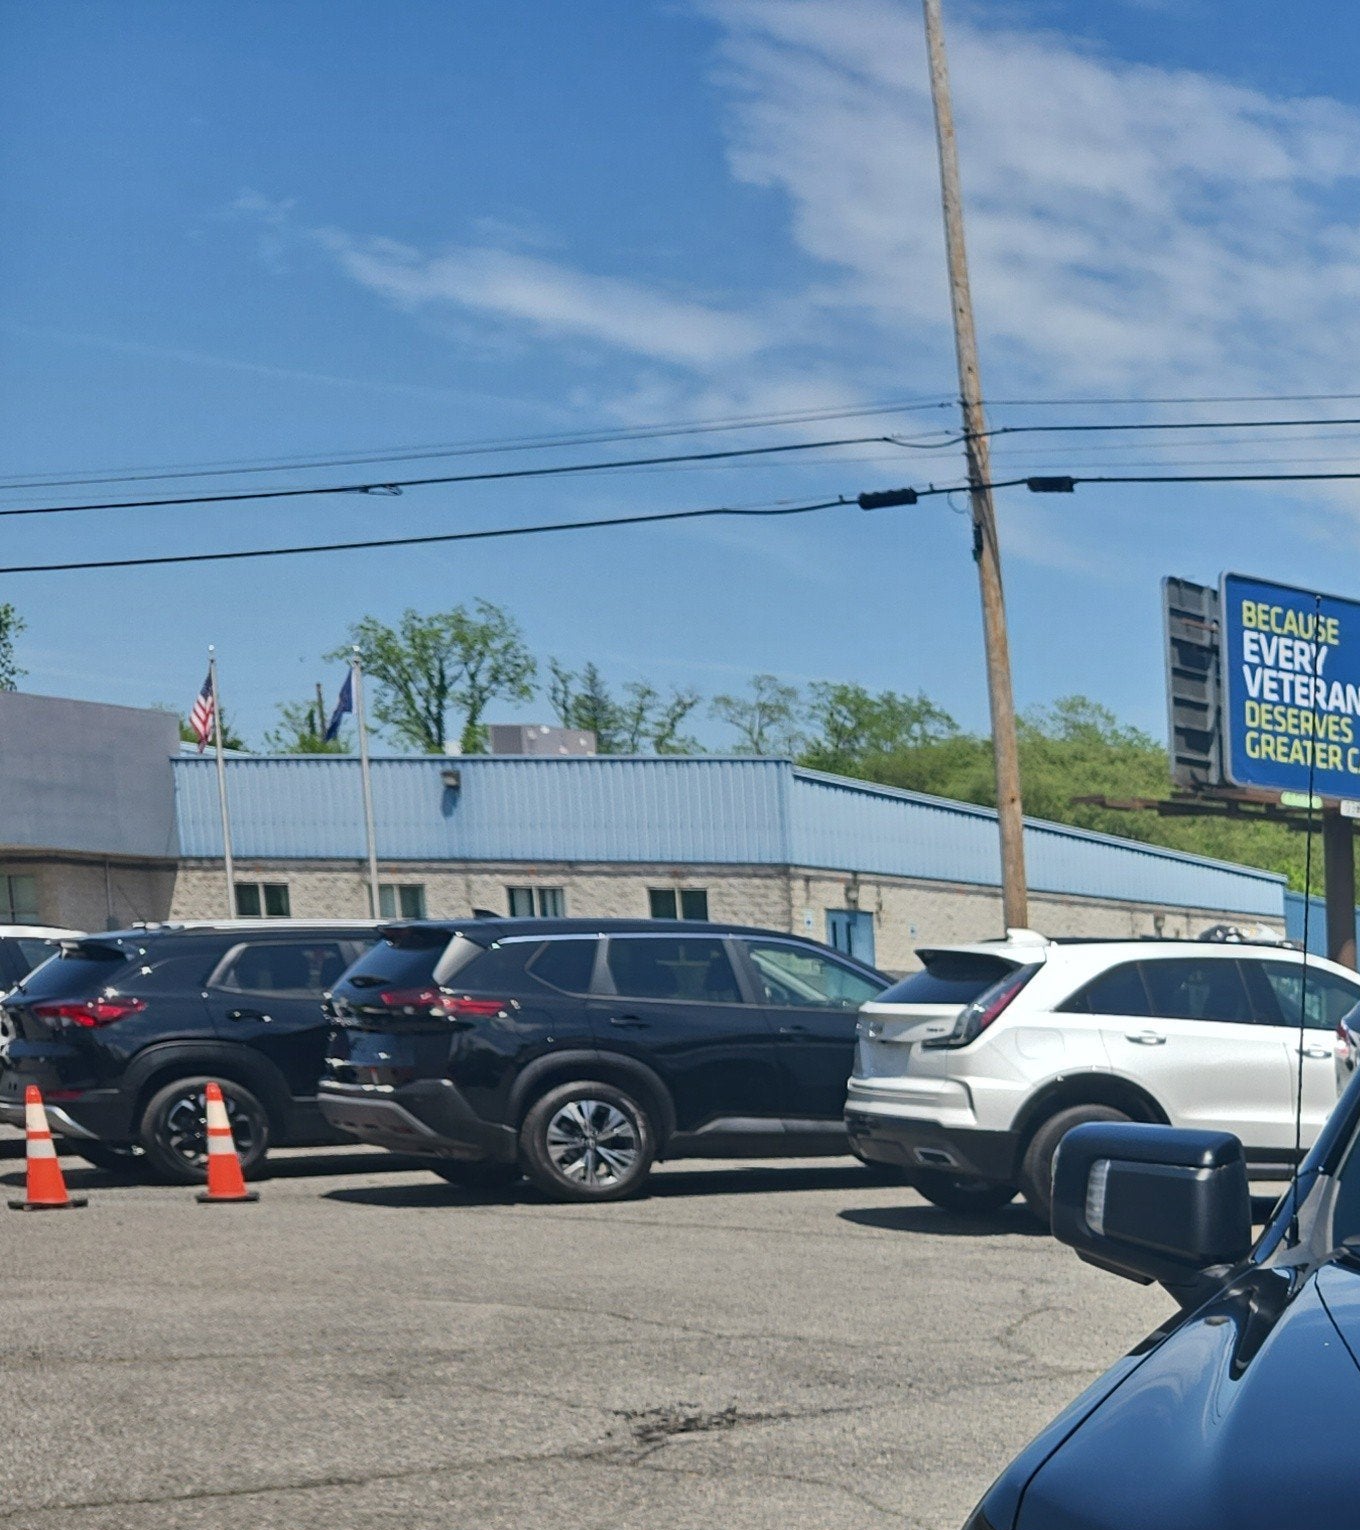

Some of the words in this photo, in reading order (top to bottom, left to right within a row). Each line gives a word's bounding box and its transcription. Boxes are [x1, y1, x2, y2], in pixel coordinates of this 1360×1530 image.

[1242, 599, 1340, 646] BECAUSE
[1243, 630, 1329, 676] EVERY
[1245, 700, 1354, 744] DESERVES
[1245, 731, 1344, 772] GREATER
